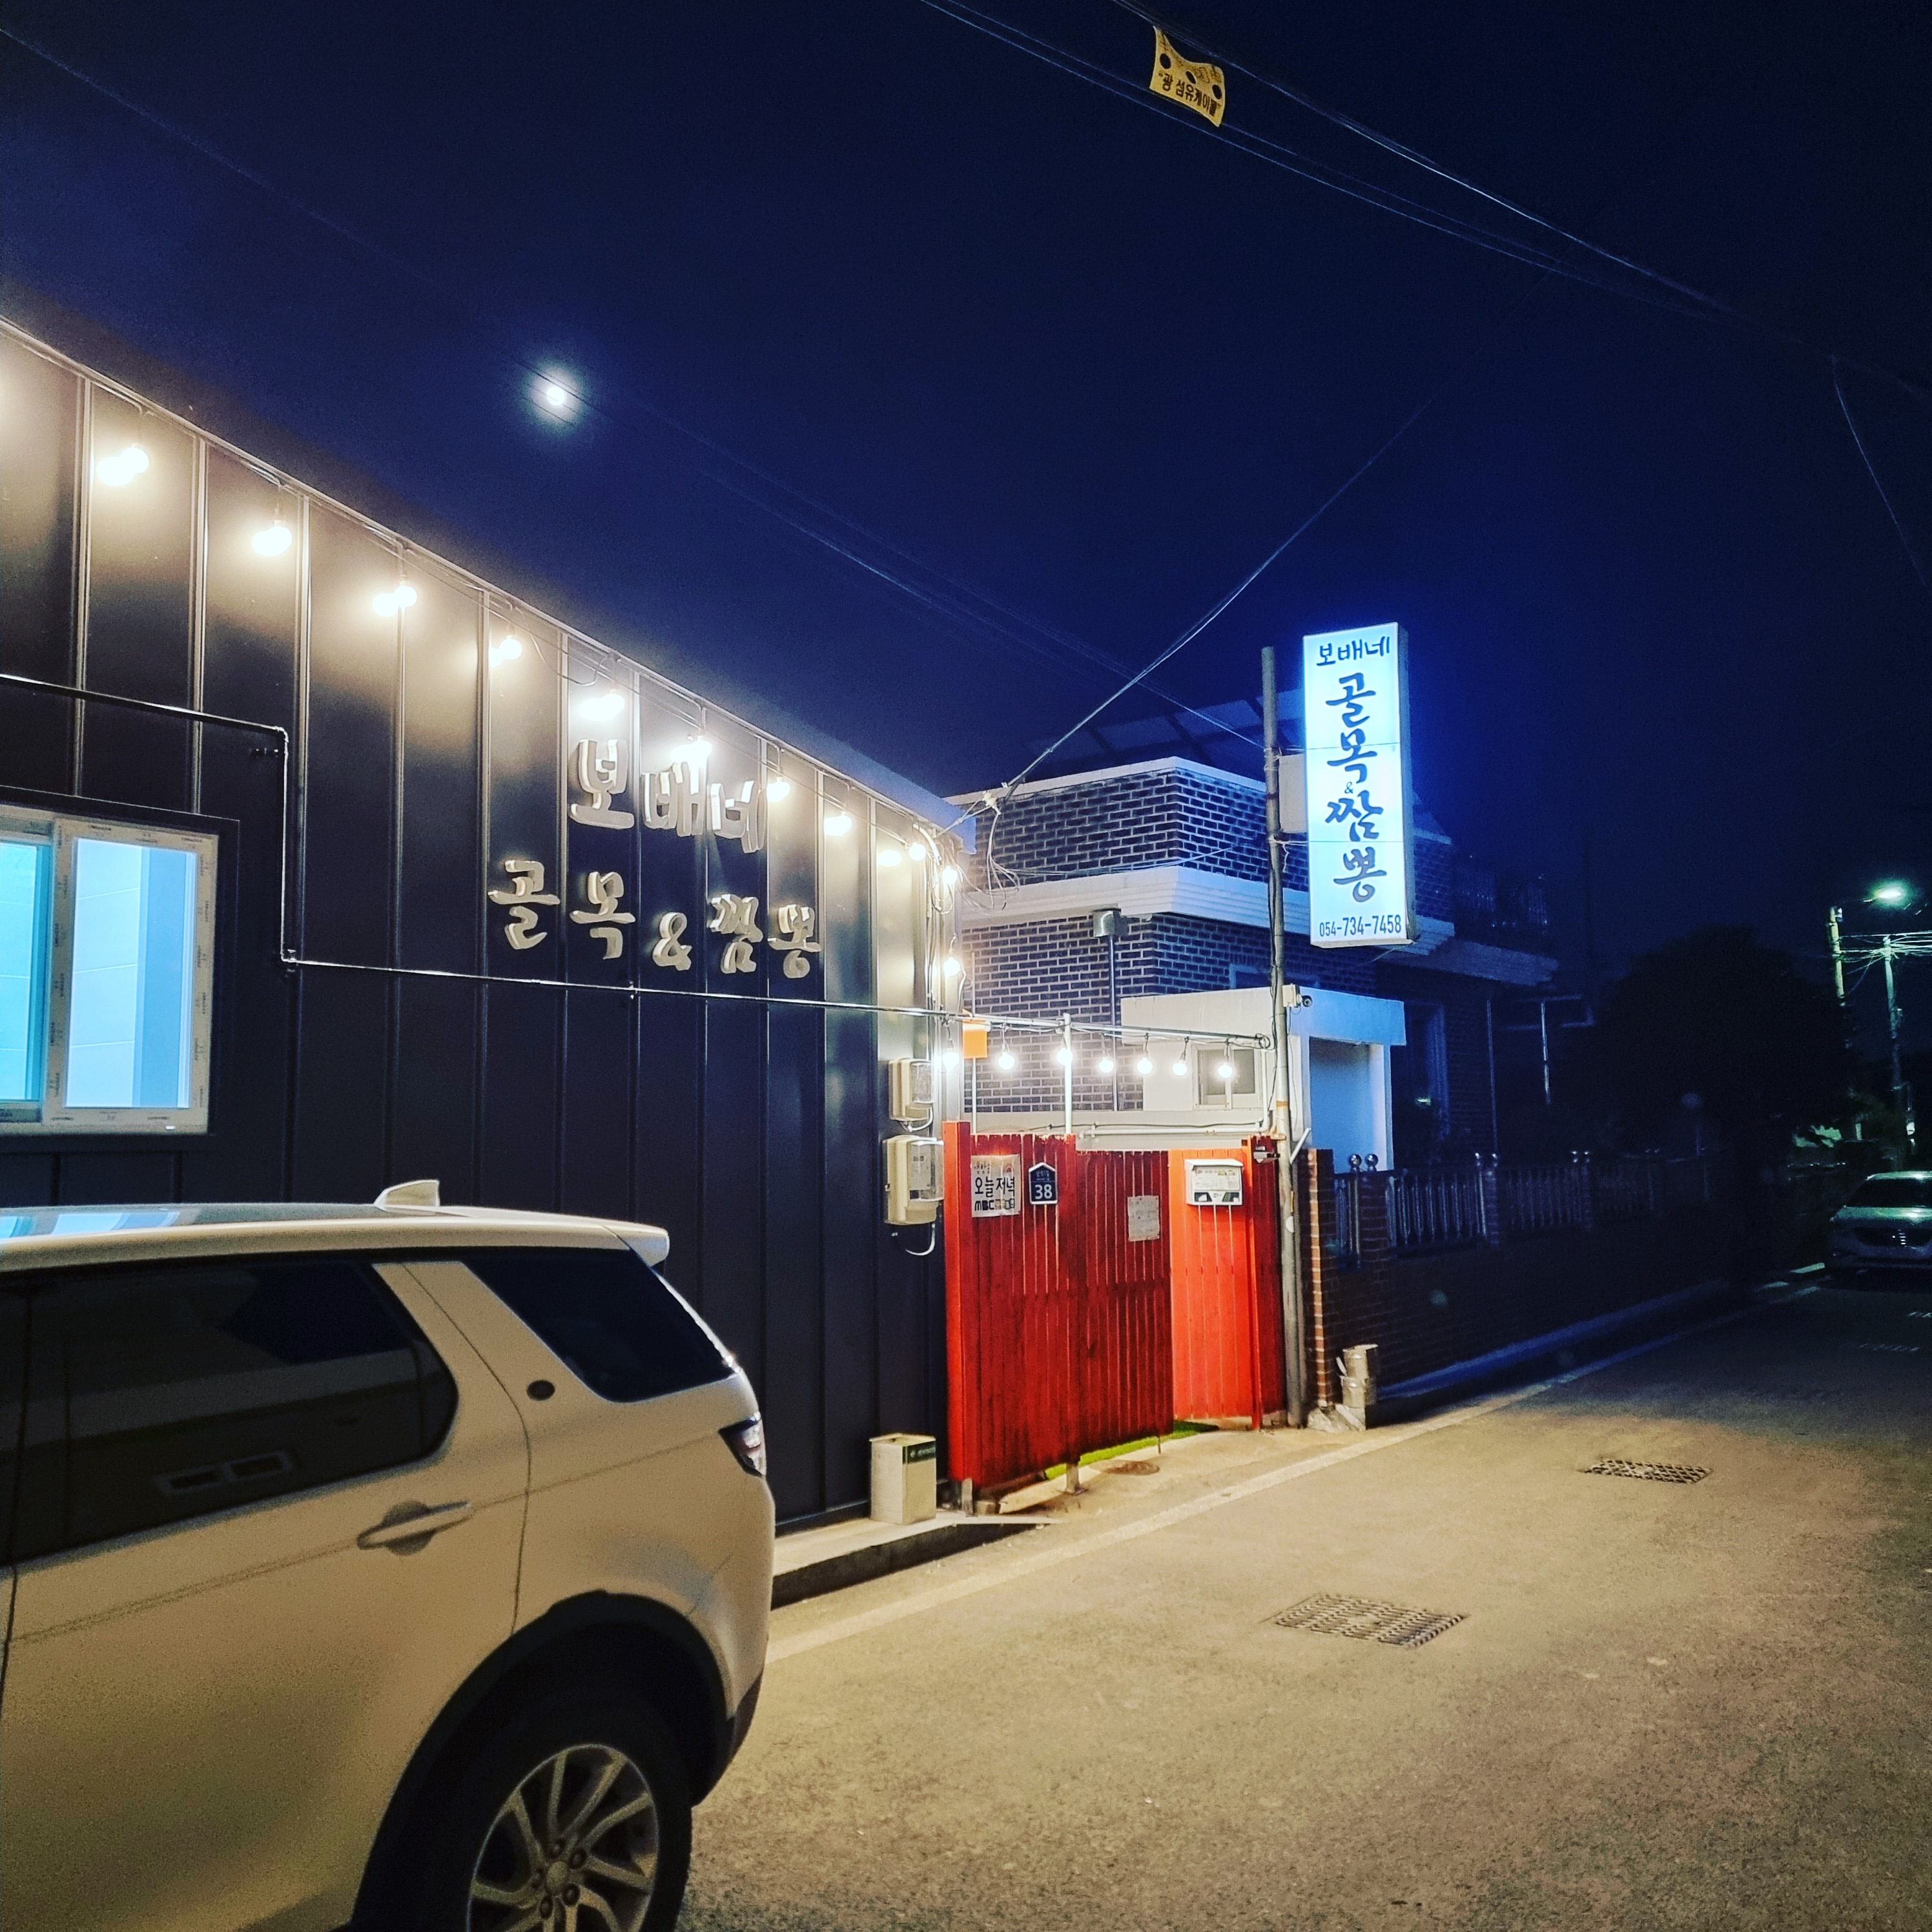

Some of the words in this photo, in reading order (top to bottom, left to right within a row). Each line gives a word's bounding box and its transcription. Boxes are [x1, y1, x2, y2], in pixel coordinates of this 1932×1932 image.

[1316, 635, 1390, 666] 보배네
[569, 738, 766, 854] 보배네
[1319, 914, 1401, 938] 054-734-7458
[1034, 1184, 1053, 1200] 38
[974, 1199, 994, 1211] MBC
